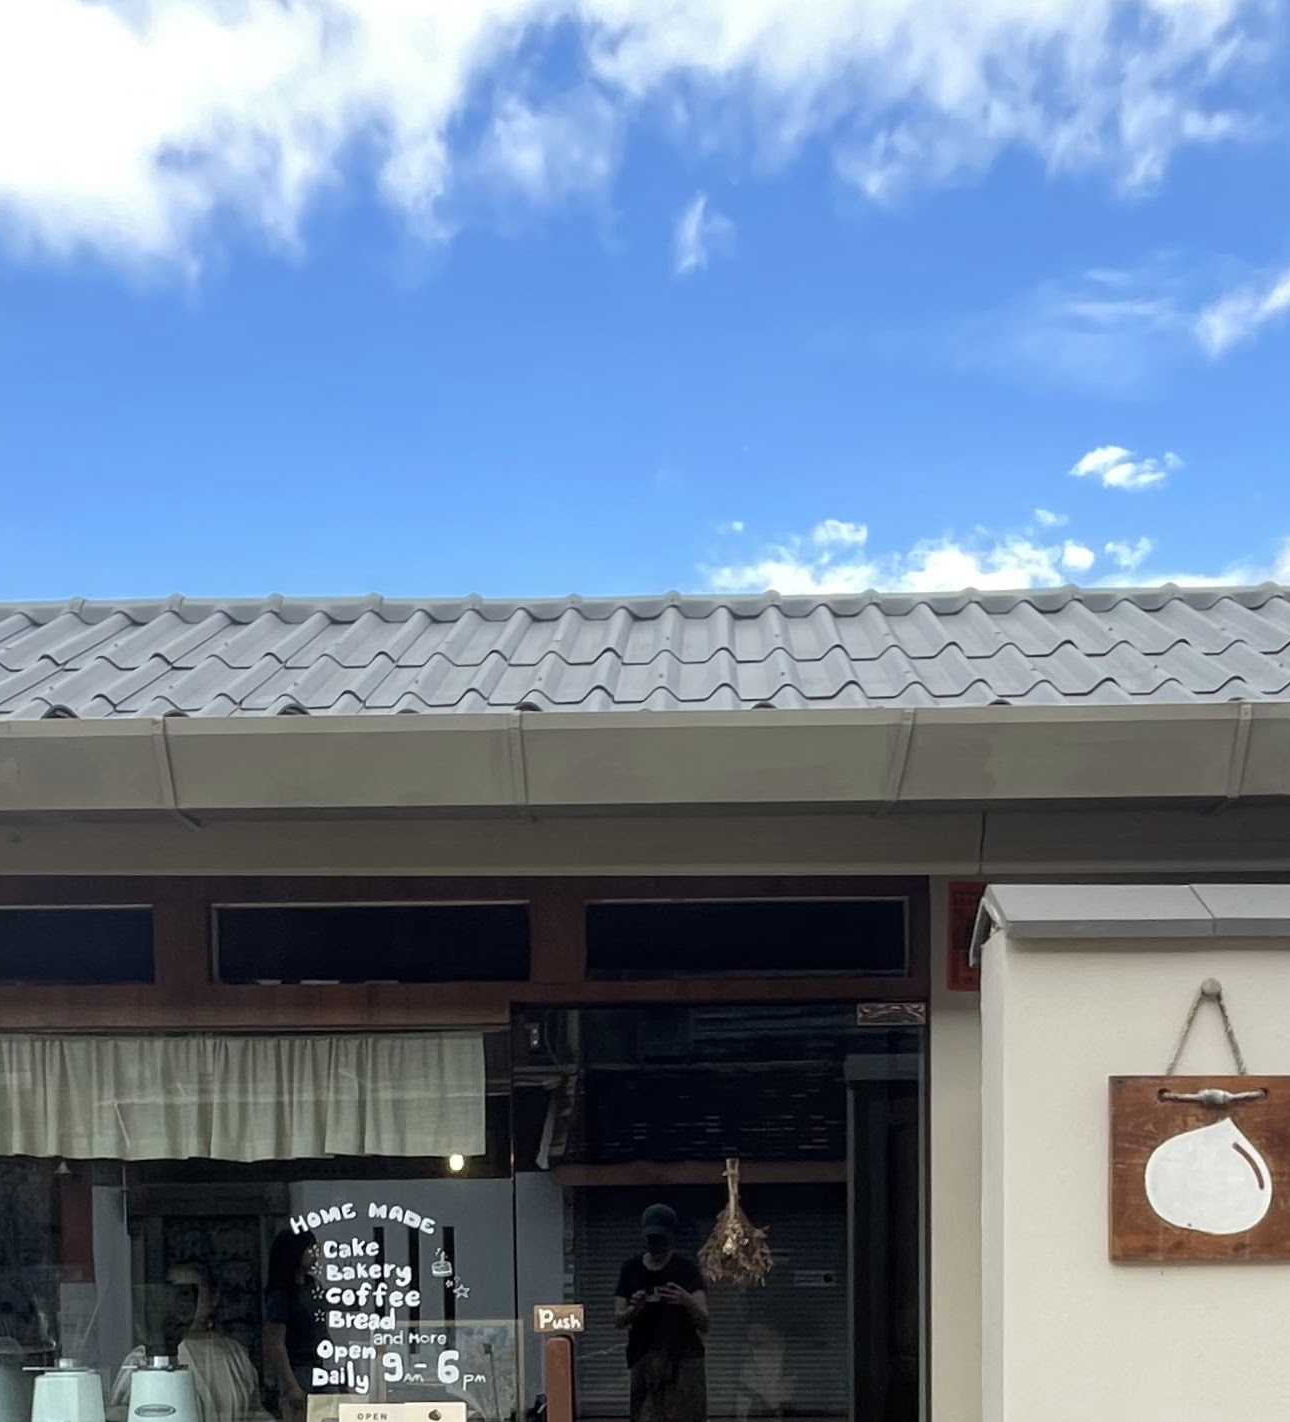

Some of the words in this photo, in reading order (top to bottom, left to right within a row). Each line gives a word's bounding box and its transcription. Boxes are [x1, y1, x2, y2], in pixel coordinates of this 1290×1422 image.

[289, 1202, 357, 1235] HOME
[368, 1202, 436, 1235] MADE
[323, 1237, 380, 1258] Cake
[326, 1262, 413, 1287] Bakery
[328, 1307, 396, 1330] Bread
[538, 1308, 581, 1330] Push
[373, 1330, 404, 1345] and
[408, 1332, 447, 1345] More
[316, 1339, 377, 1363] Open
[312, 1360, 370, 1394] Daily
[357, 1412, 388, 1421] OPEN
